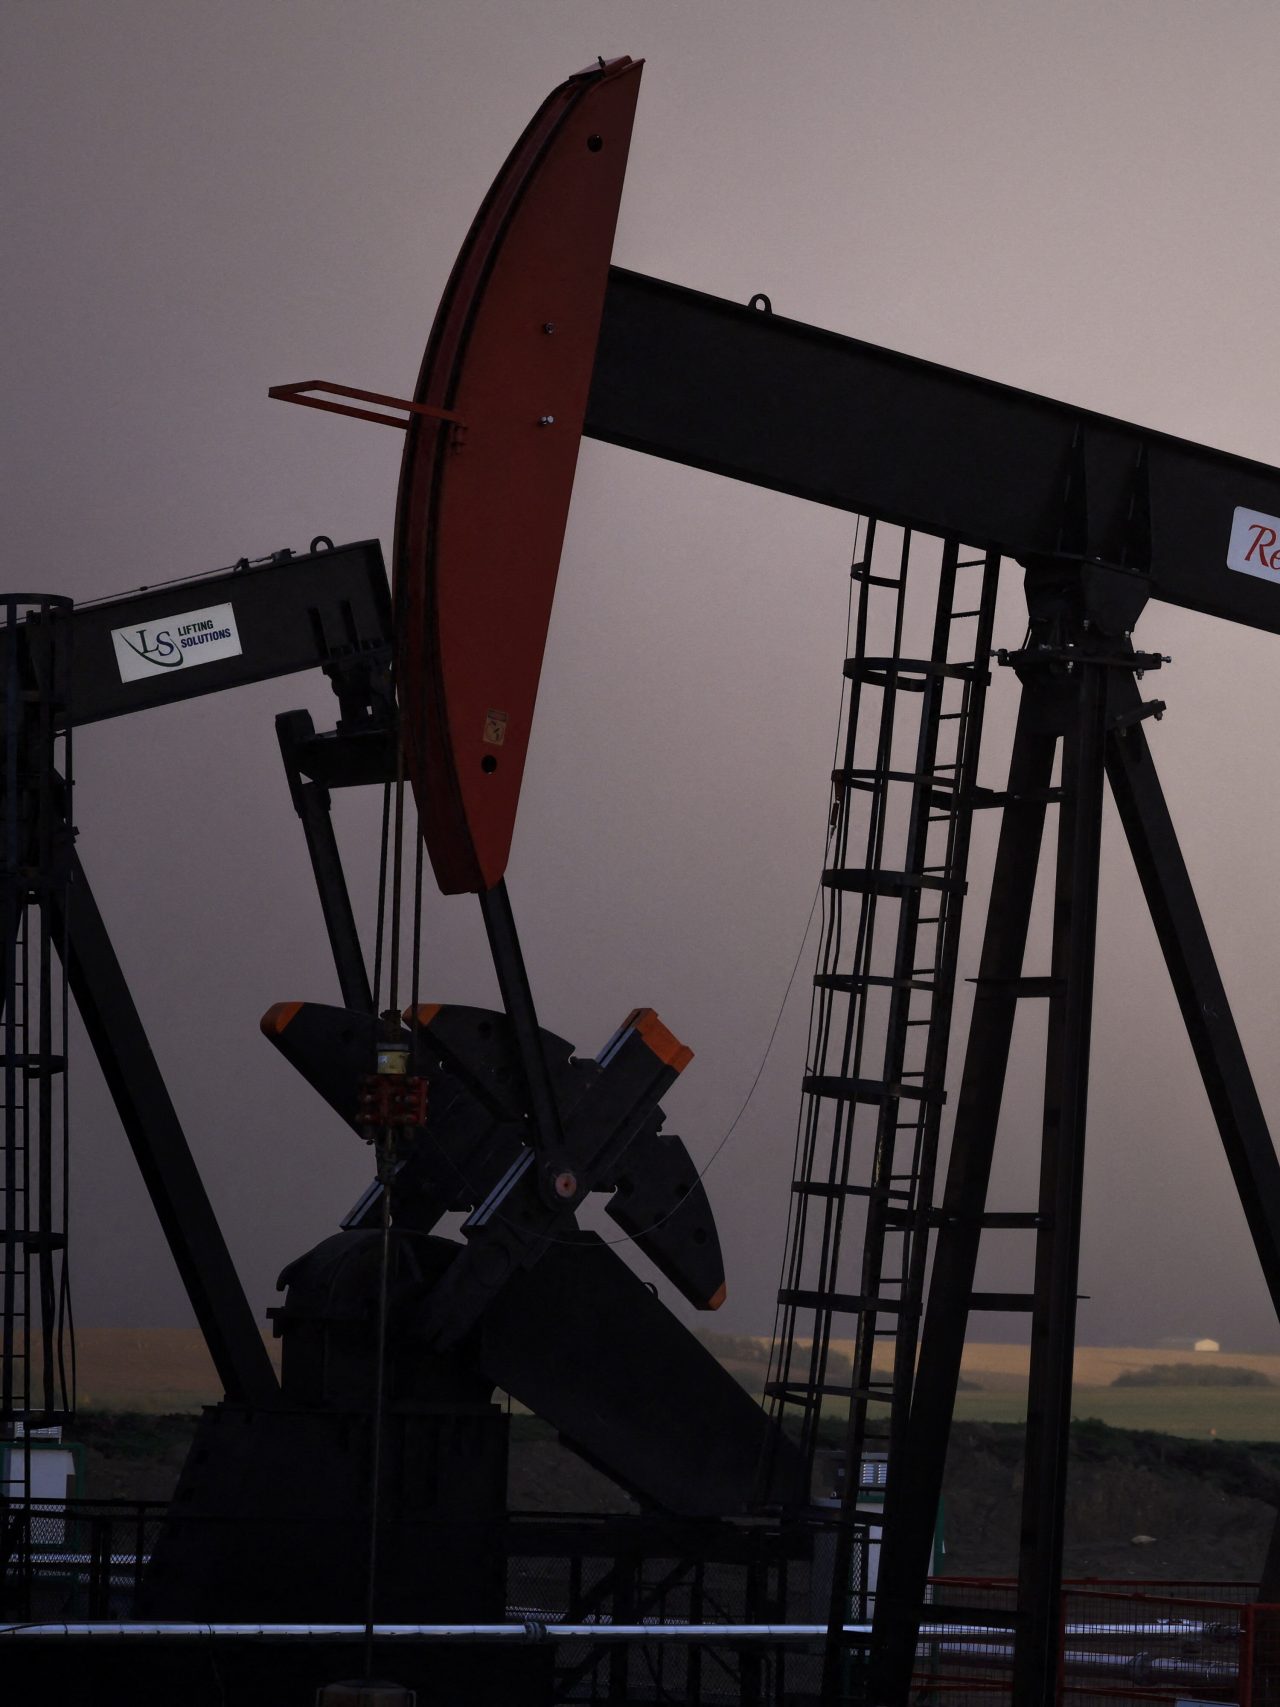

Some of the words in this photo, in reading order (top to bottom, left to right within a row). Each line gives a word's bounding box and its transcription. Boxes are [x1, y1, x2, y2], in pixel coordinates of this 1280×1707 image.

[177, 619, 214, 637] LIFTING
[180, 628, 231, 649] SOLUTIONS
[136, 629, 175, 656] LS
